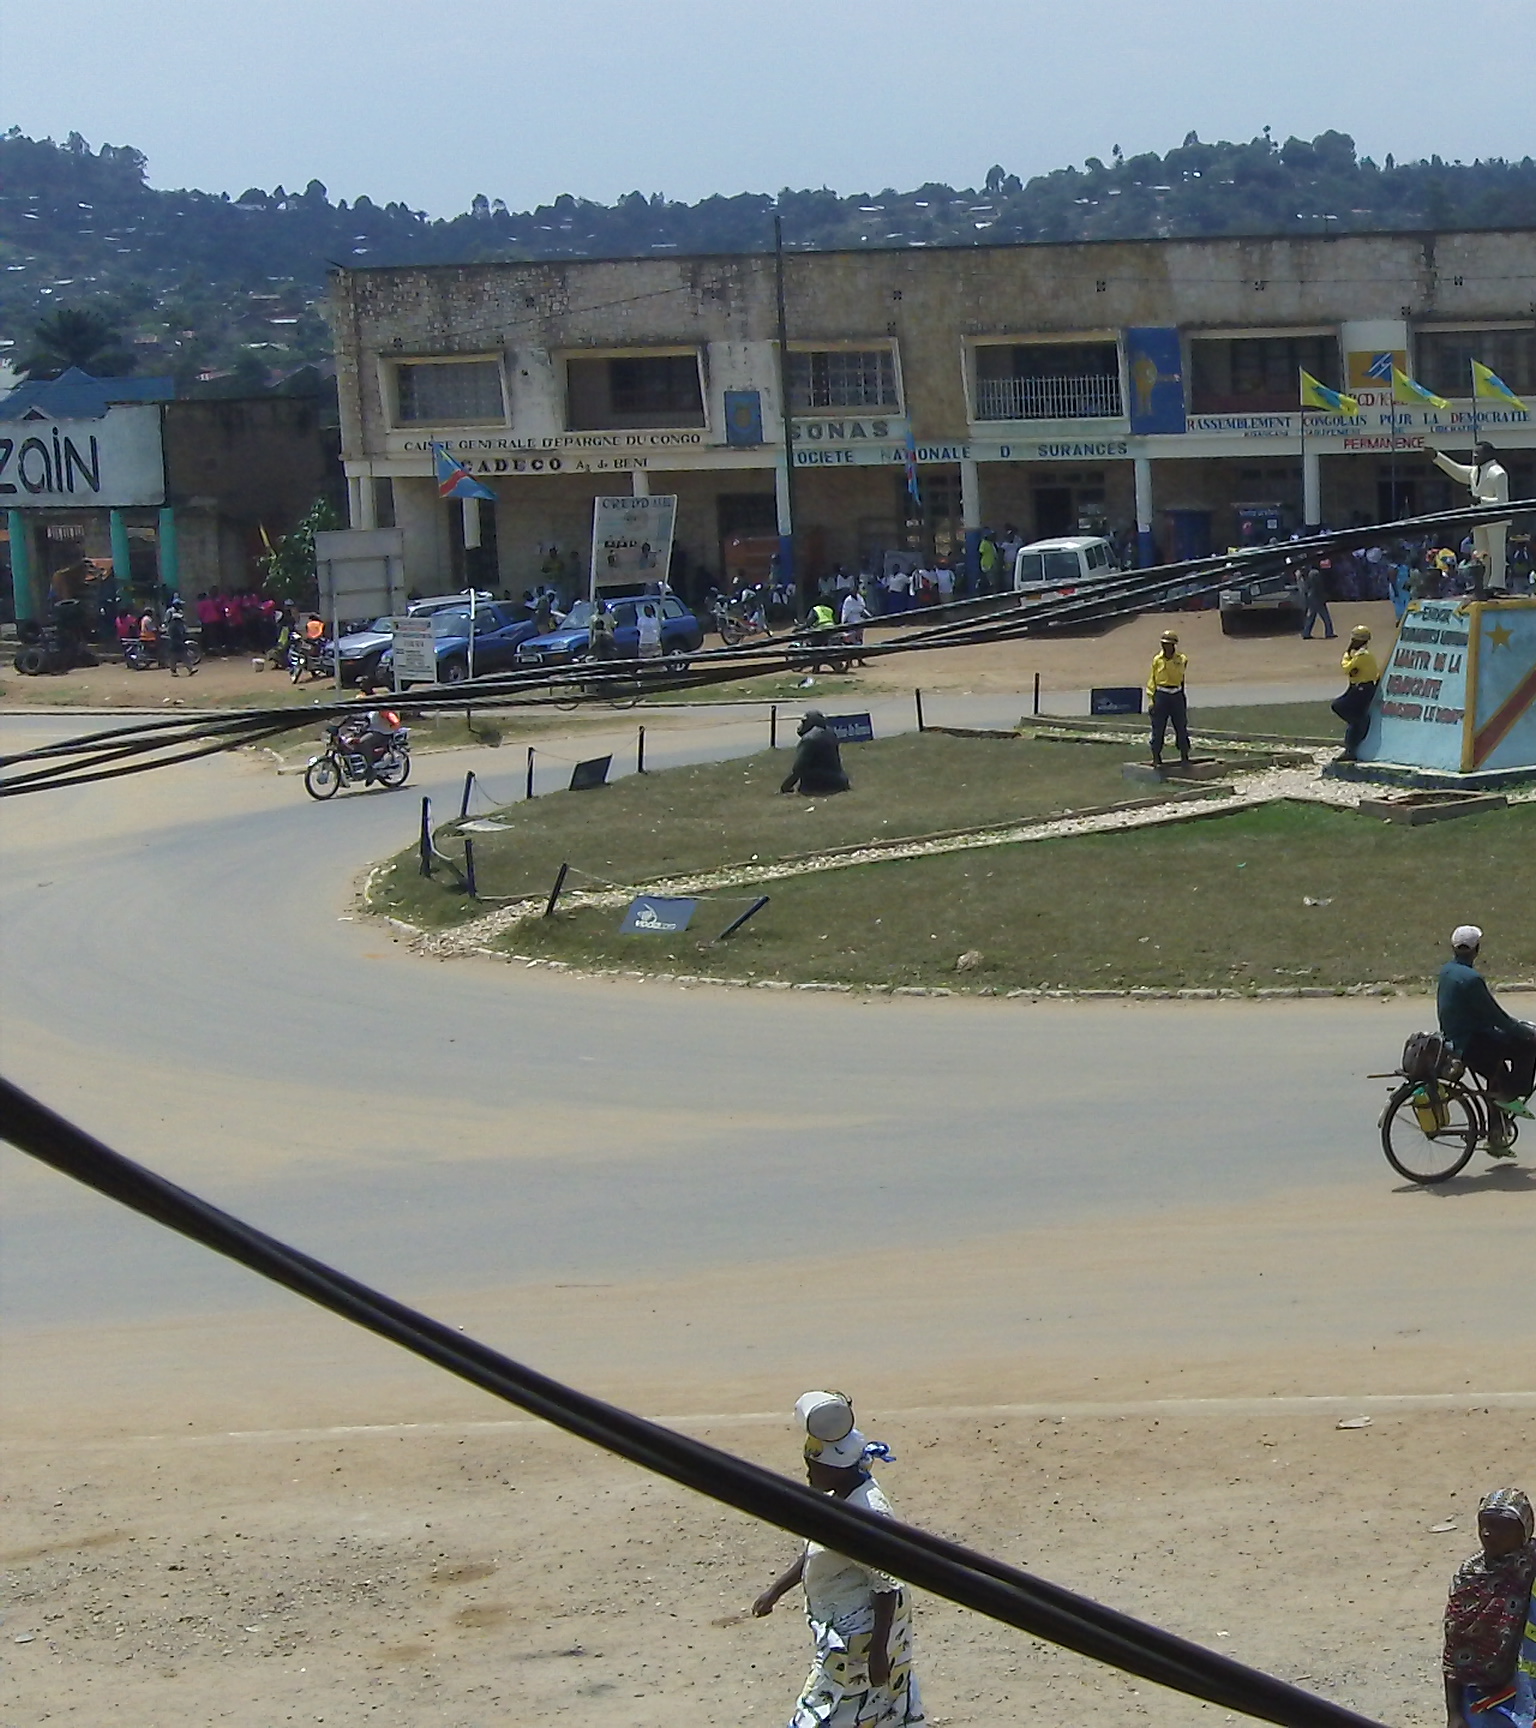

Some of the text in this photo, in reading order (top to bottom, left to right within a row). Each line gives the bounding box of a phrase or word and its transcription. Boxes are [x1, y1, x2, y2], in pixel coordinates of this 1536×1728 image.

[1380, 413, 1412, 425] POUR
[1424, 412, 1440, 424] LA
[1451, 410, 1531, 424] DEMOCRATIE
[791, 420, 889, 440] SONAS
[404, 440, 454, 451] CAISSE
[458, 437, 537, 450] GENERALE
[626, 434, 647, 446] DU
[650, 433, 702, 445] CONGO
[1343, 436, 1426, 450] PERMANENCE
[795, 449, 854, 465] OCIETE
[880, 446, 971, 462] NAONALE
[460, 457, 563, 473] CADECO
[613, 457, 649, 469] BENI
